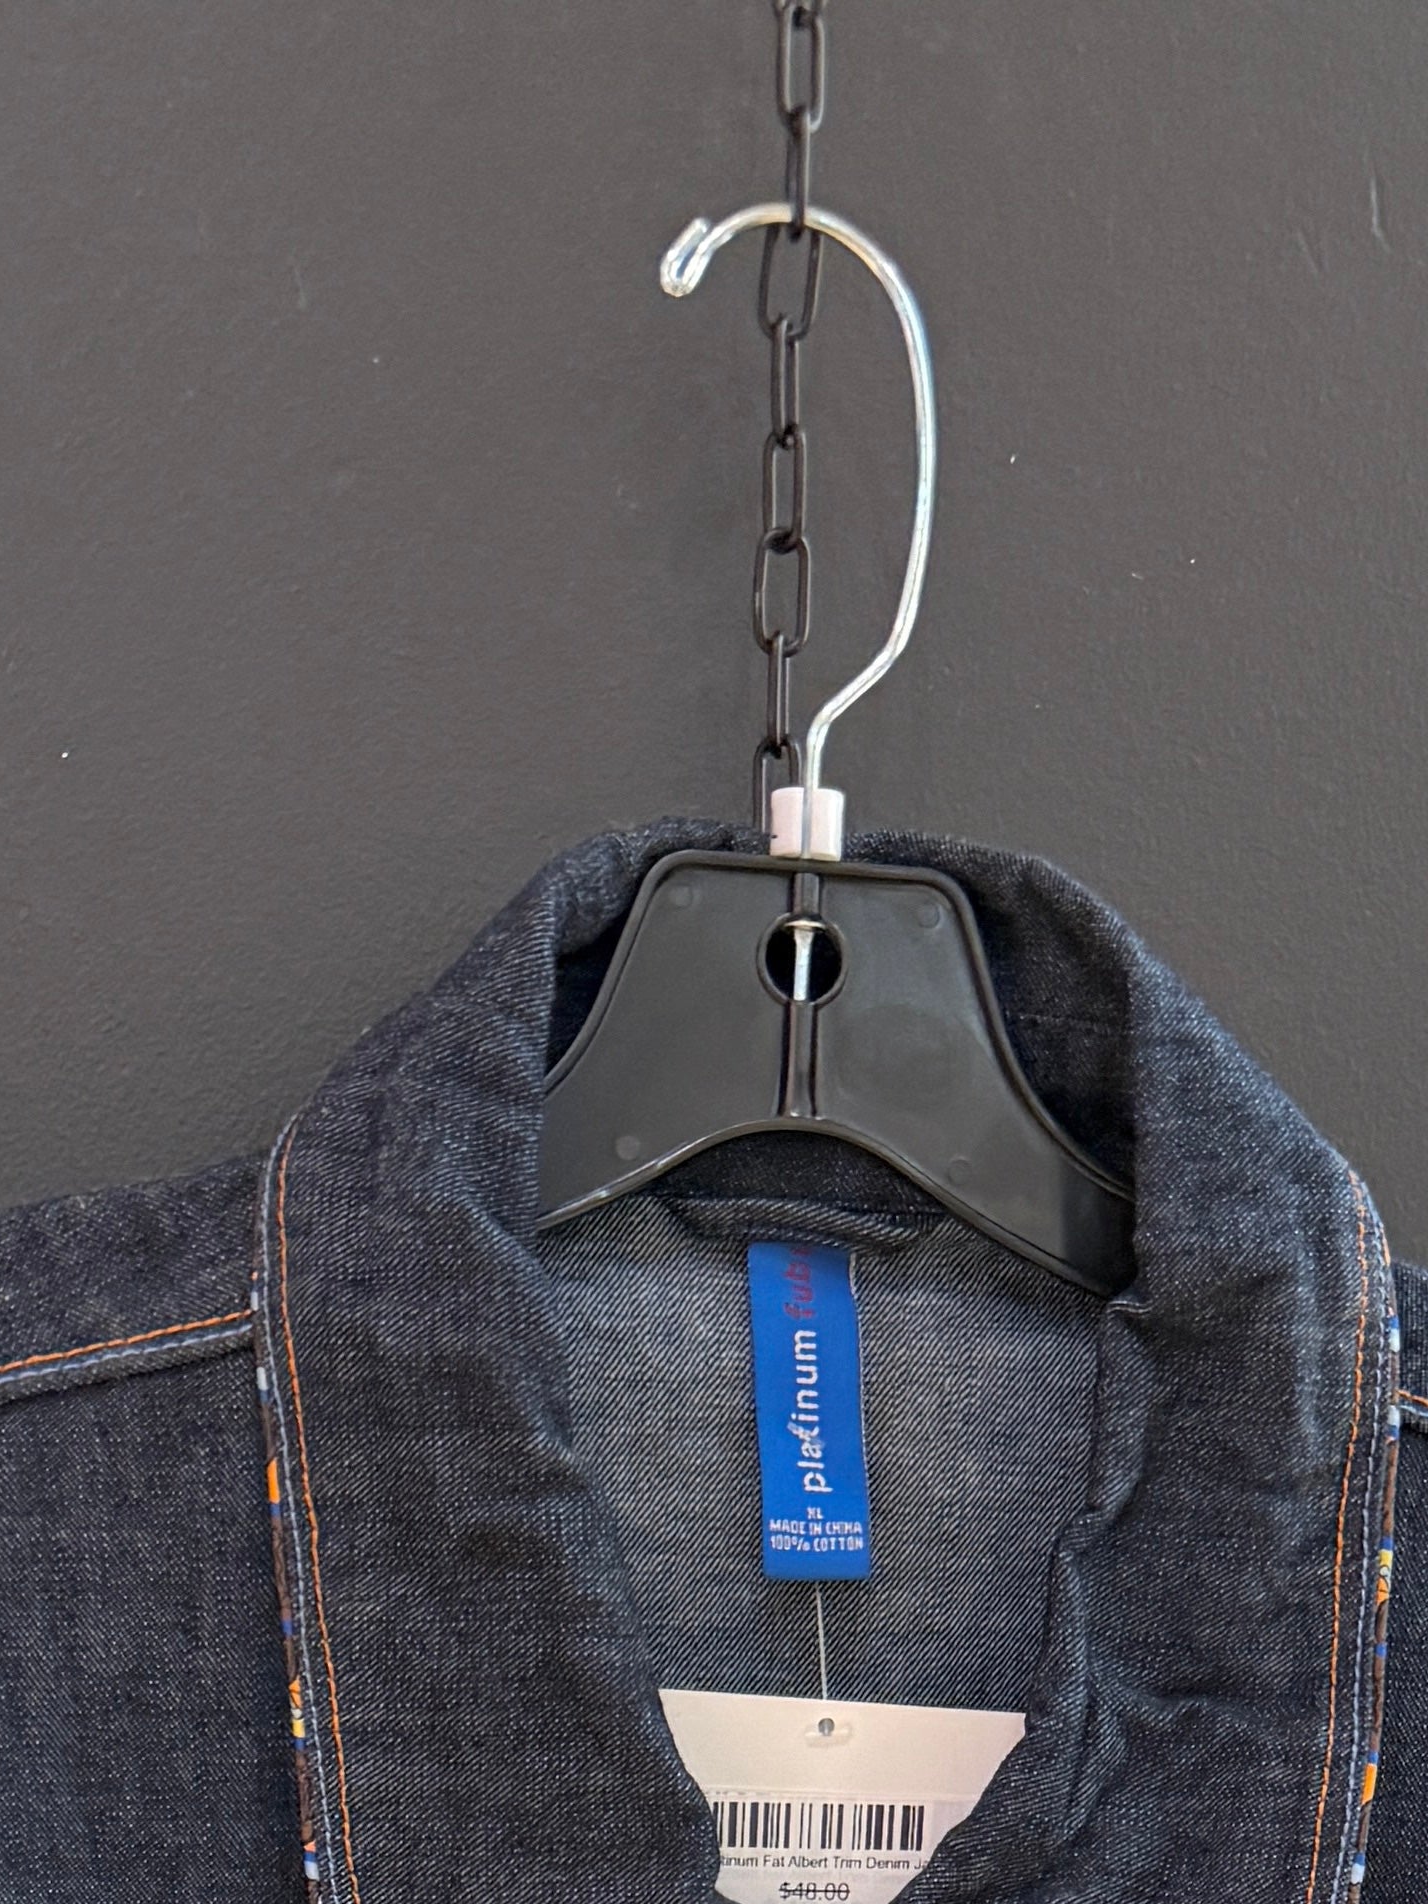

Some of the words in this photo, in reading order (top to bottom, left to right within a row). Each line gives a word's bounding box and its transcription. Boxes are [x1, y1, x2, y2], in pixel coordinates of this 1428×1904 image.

[787, 1329, 832, 1493] platinum
[807, 1507, 824, 1519] XL
[769, 1519, 806, 1534] MADE
[809, 1521, 822, 1535] IN
[825, 1521, 862, 1535] CHINA
[770, 1534, 811, 1551] 100%
[813, 1536, 864, 1552] COTTON
[720, 1855, 759, 1867] tinum
[763, 1854, 785, 1868] Fat
[788, 1855, 828, 1868] Albert
[833, 1856, 862, 1869] Trim
[866, 1856, 910, 1869] Denim
[914, 1858, 929, 1869] Ja
[778, 1882, 850, 1901] $48.00
